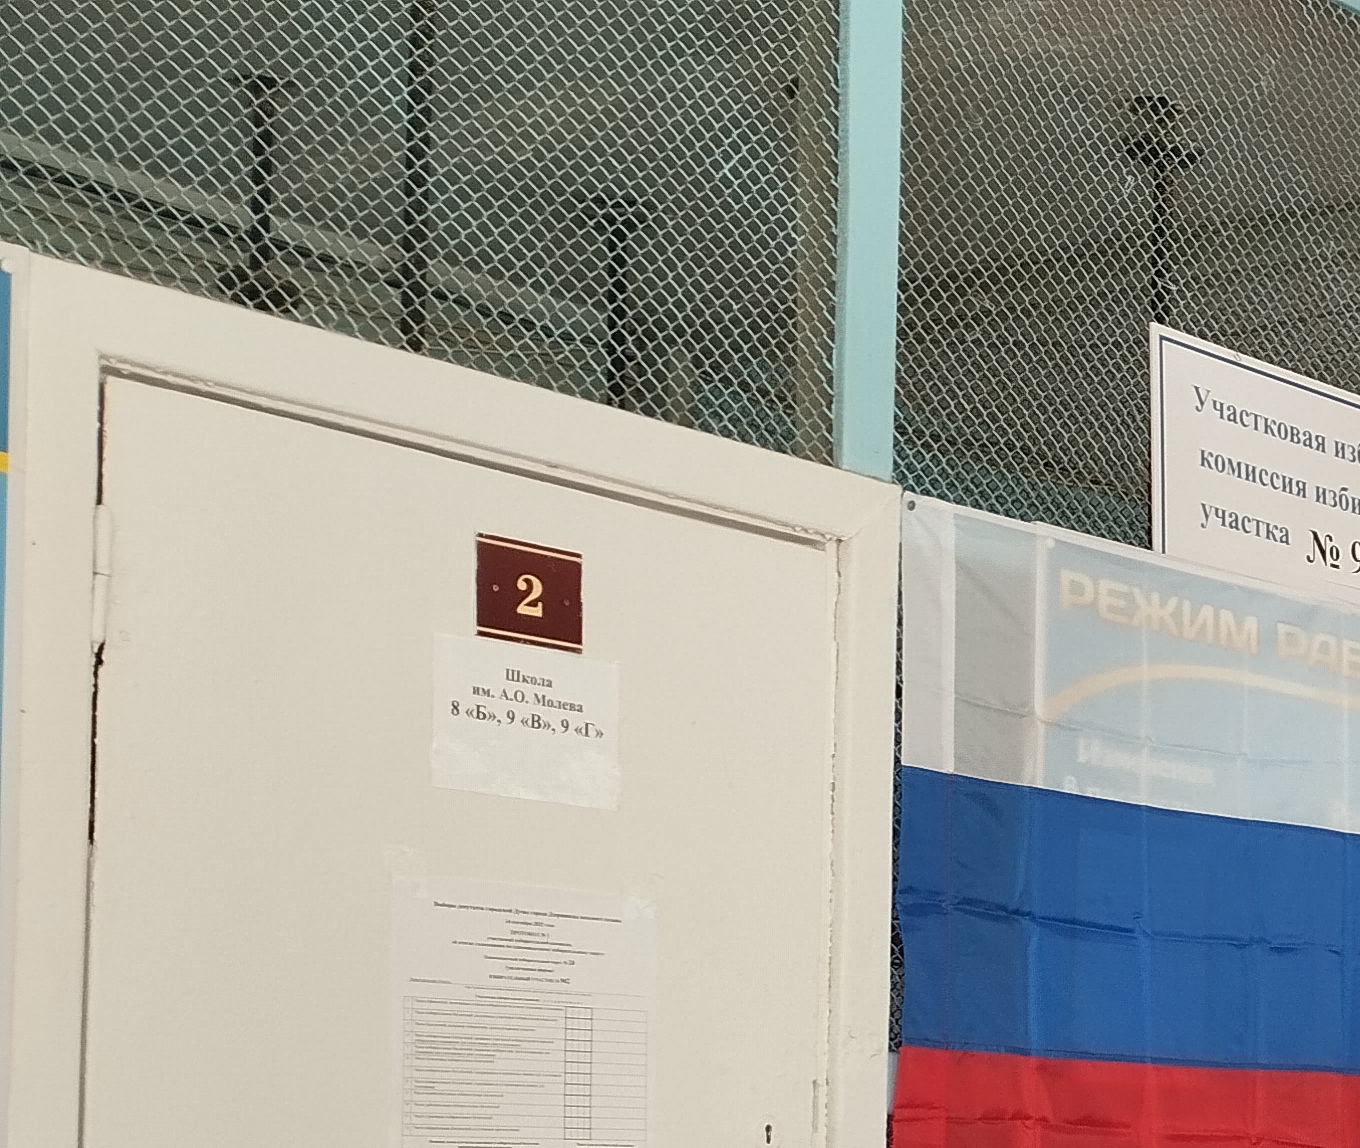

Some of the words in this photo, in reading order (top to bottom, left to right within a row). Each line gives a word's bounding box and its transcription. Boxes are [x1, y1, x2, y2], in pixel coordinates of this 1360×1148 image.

[1191, 383, 1327, 454] Участковая
[1199, 447, 1308, 499] комиссия
[1199, 502, 1291, 546] участка
[1306, 529, 1341, 570] №
[516, 574, 543, 618] 2
[1059, 567, 1259, 655] РЕЖИМ
[472, 685, 496, 699] им.
[499, 689, 529, 704] А.О.
[533, 692, 584, 714] Молева
[505, 668, 553, 689] Школа
[451, 700, 460, 716] 8
[506, 709, 516, 726] 9
[560, 718, 569, 734] 9
